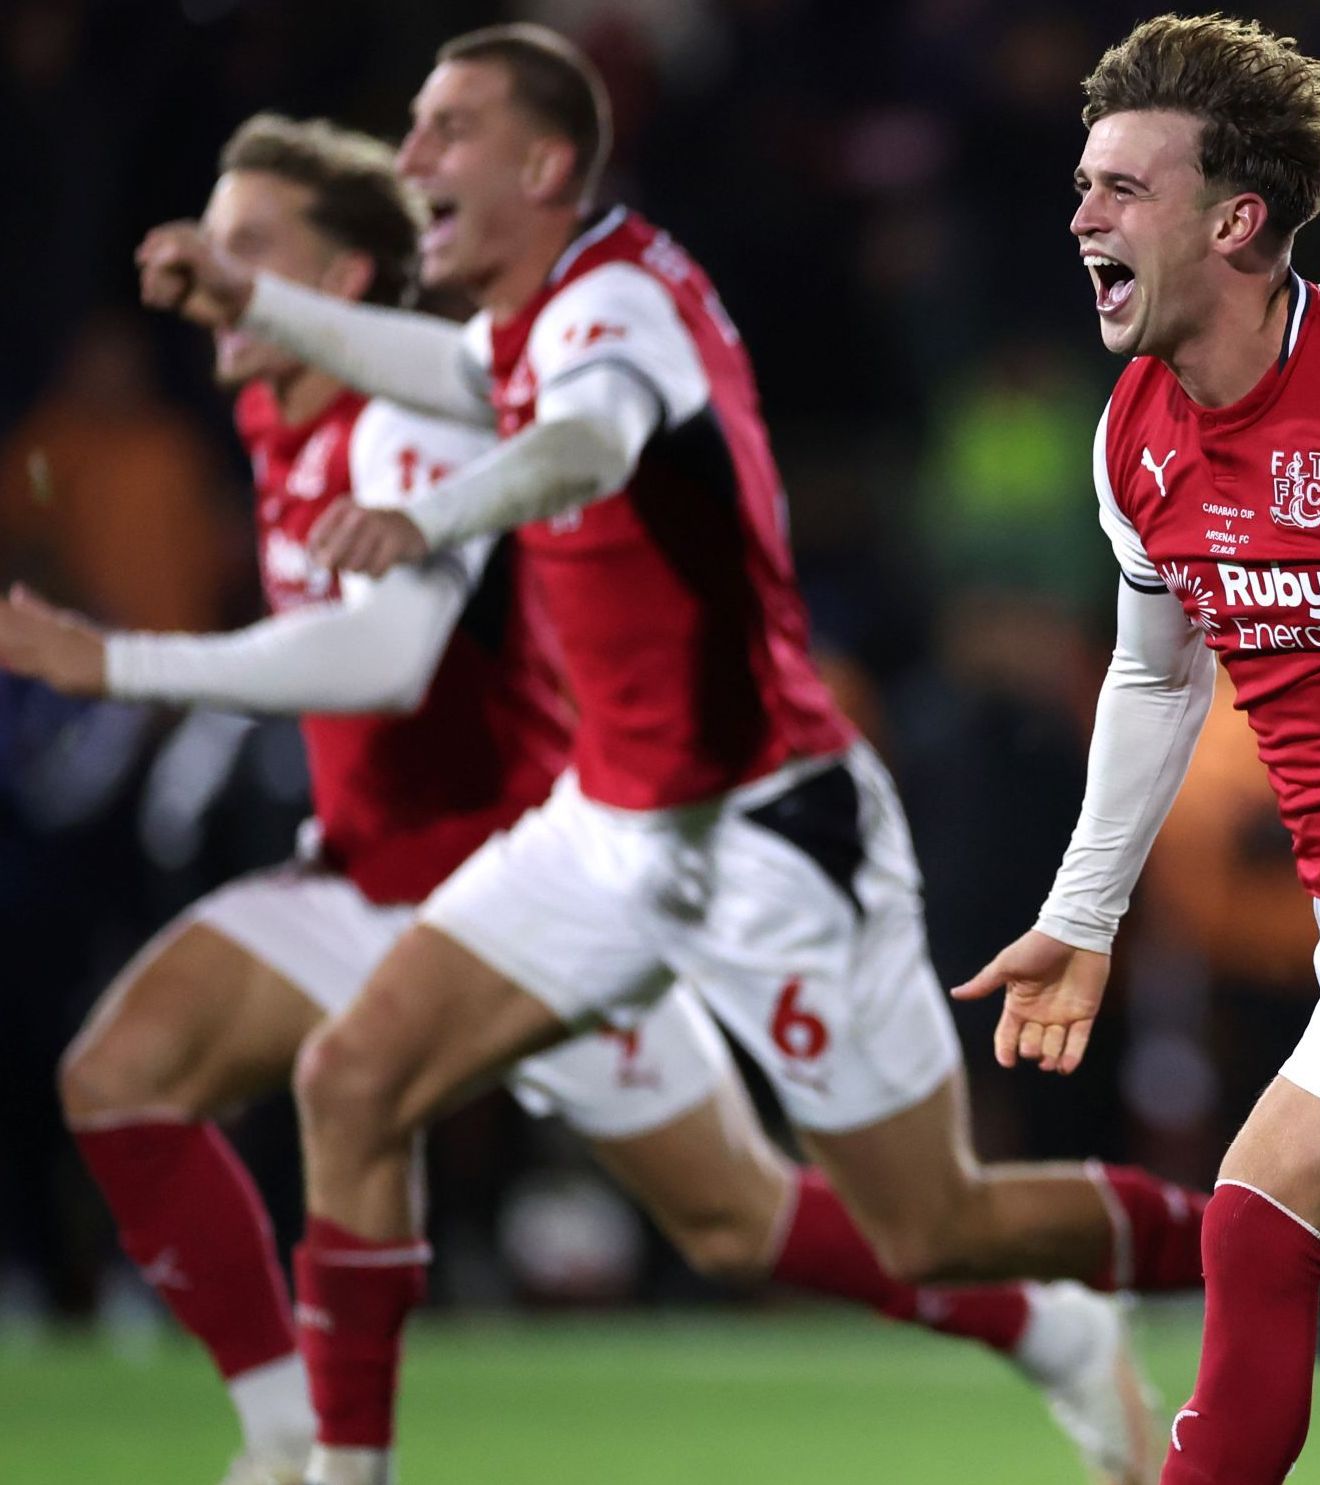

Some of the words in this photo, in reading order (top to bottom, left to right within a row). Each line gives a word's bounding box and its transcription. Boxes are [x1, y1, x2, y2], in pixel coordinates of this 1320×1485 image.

[1202, 502, 1238, 518] CARABAO
[1240, 508, 1255, 519] CUP
[1225, 519, 1232, 531] V
[1205, 529, 1237, 544] ARSENAL
[1238, 534, 1250, 544] FC
[769, 972, 830, 1061] 6
